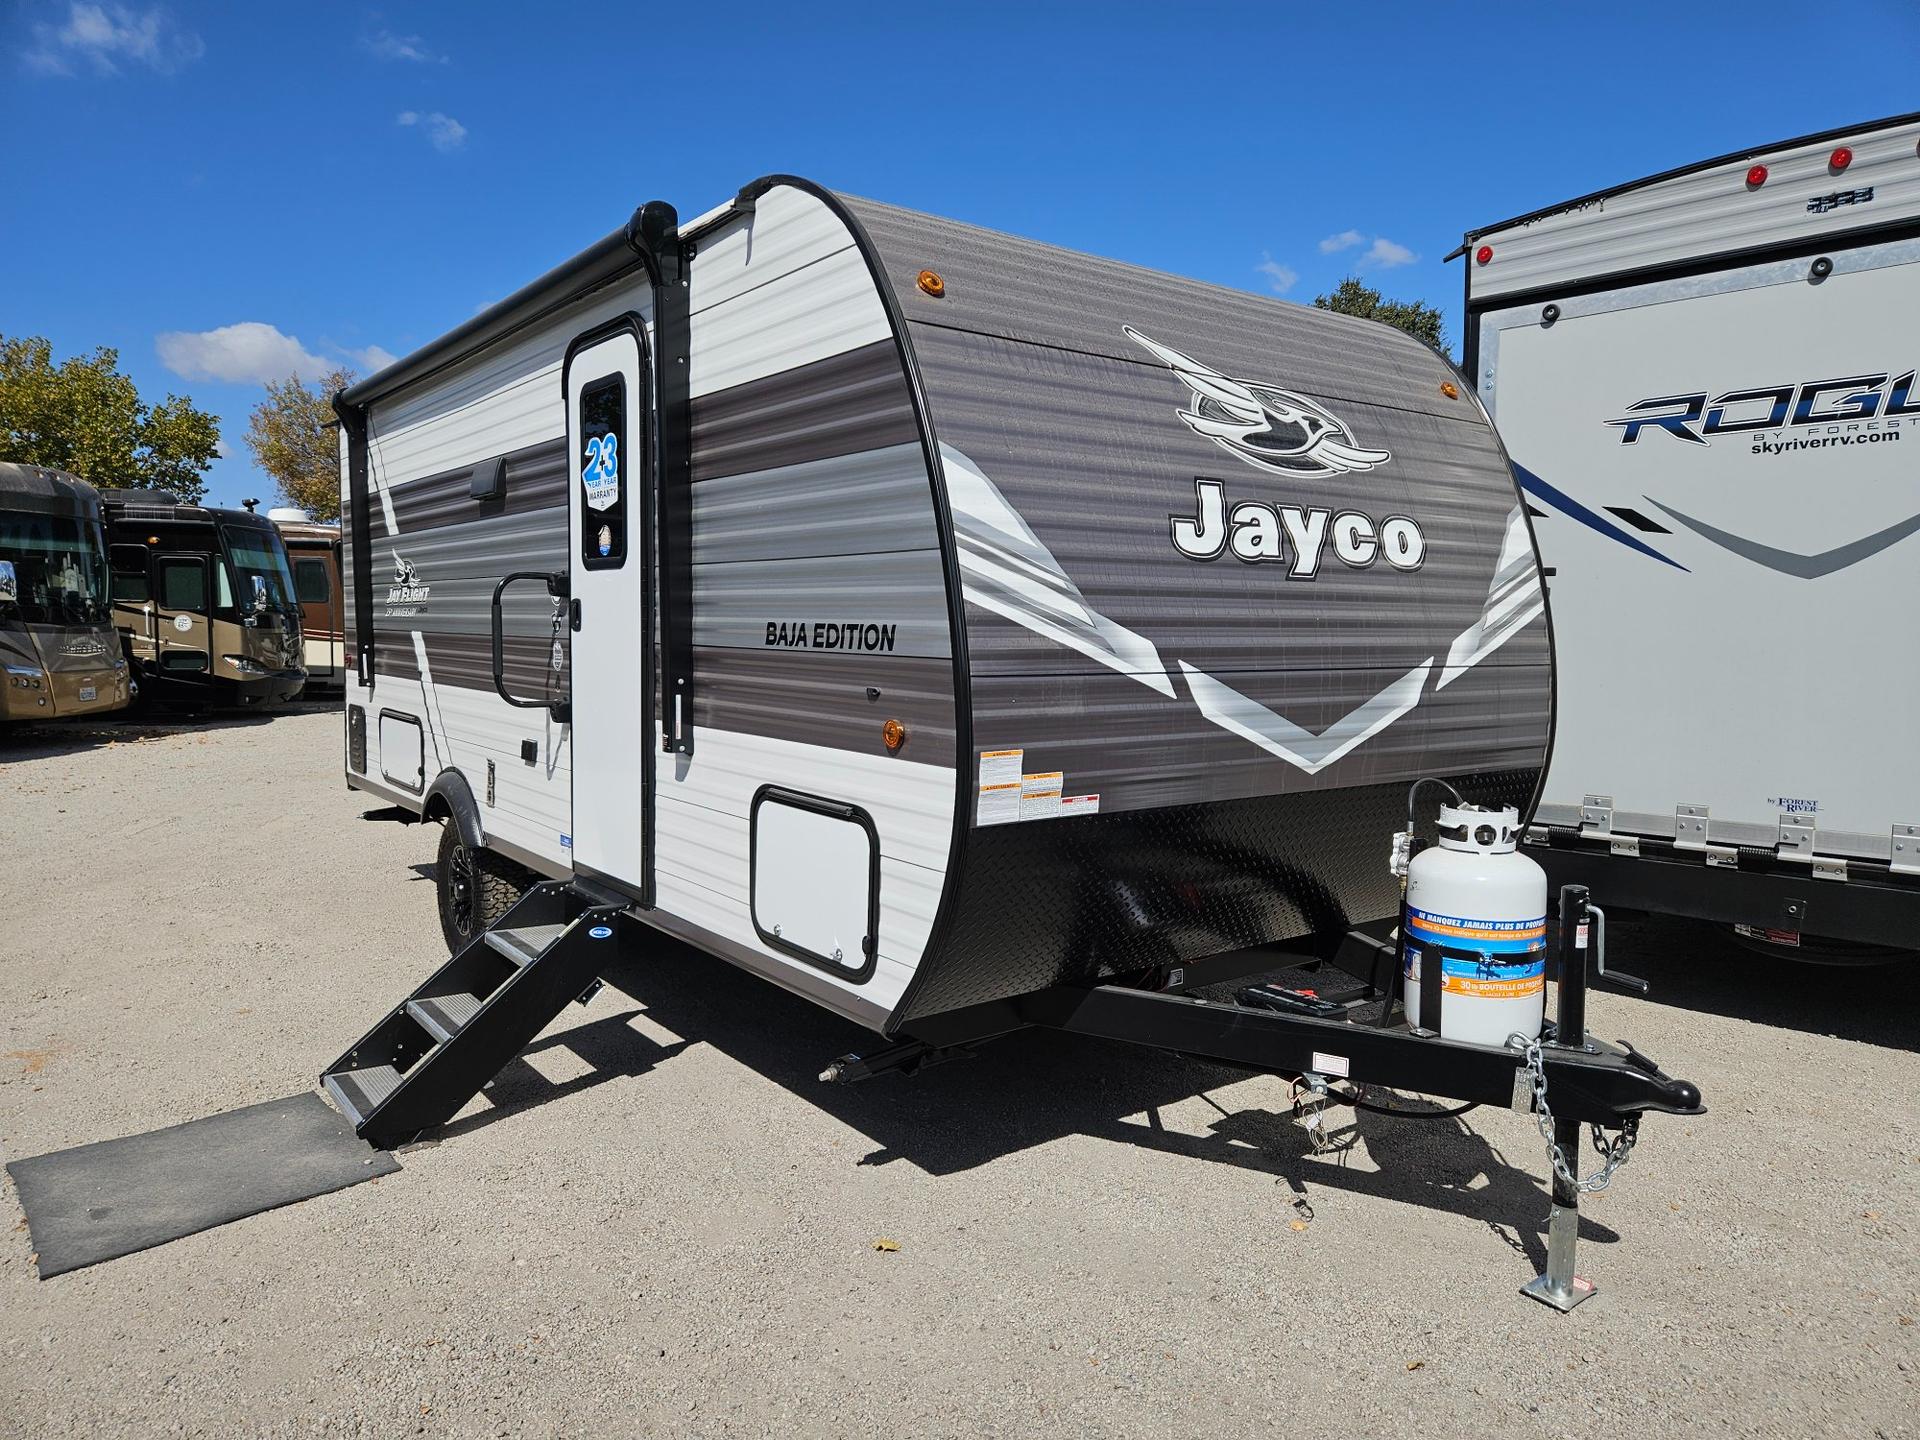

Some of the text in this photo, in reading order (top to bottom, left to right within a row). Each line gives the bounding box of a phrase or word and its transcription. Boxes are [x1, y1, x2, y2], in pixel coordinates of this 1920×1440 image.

[1753, 418, 1920, 442] BY FOREST
[1751, 431, 1900, 455] skyriverrv.com
[589, 488, 617, 500] WARRANTY
[1168, 476, 1426, 581] Jayco
[765, 622, 897, 651] BAJA EDITION
[1786, 804, 1817, 812] RIVER
[1426, 914, 1461, 927] MANQUEZ
[1462, 920, 1494, 930] JAMAIS
[1495, 922, 1515, 930] PLUS
[1515, 922, 1525, 930] DE
